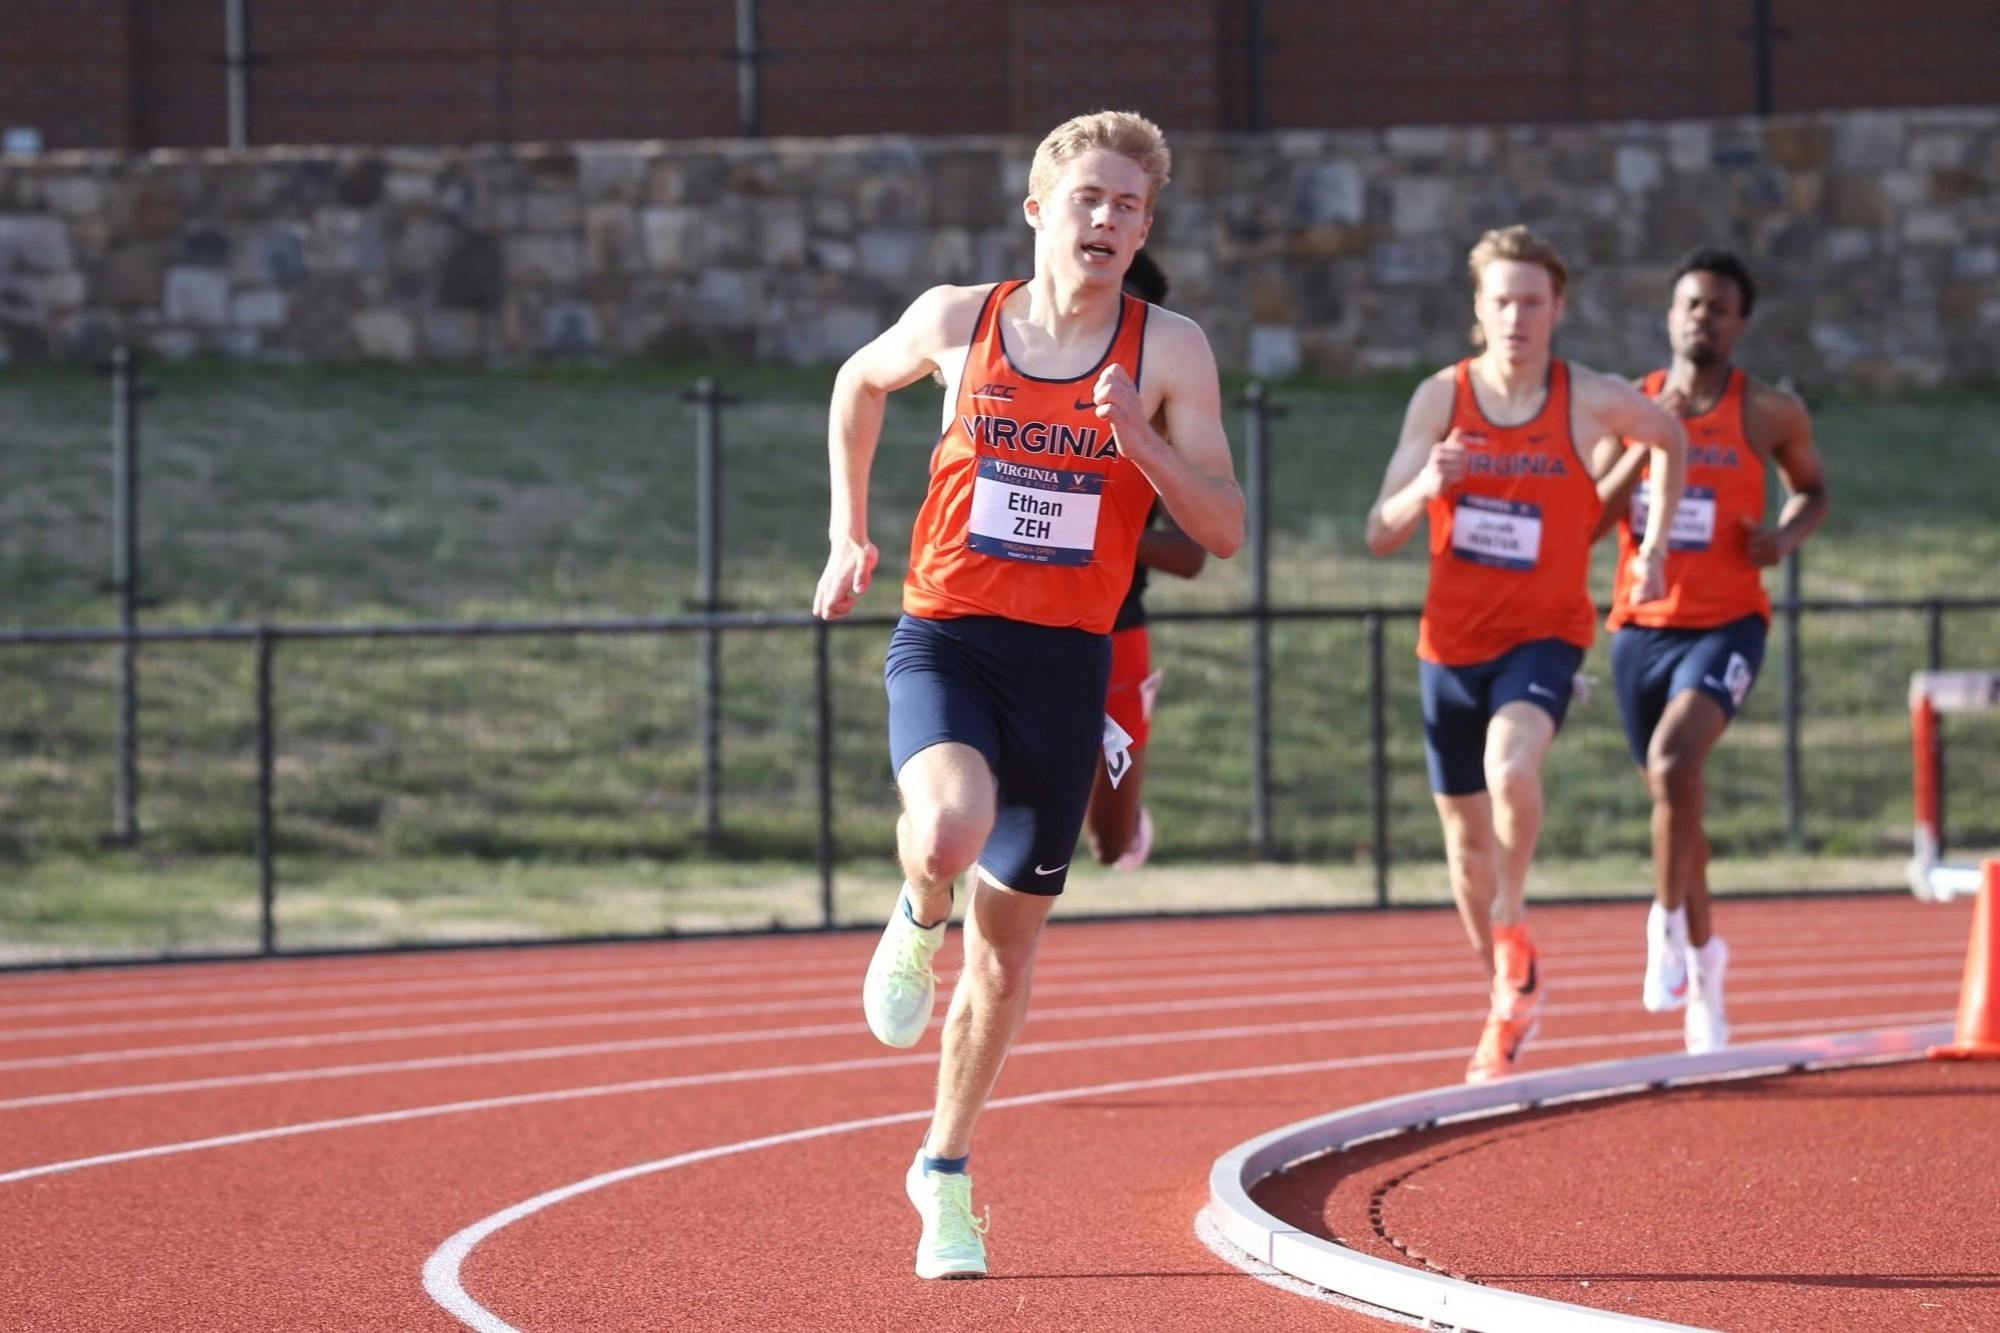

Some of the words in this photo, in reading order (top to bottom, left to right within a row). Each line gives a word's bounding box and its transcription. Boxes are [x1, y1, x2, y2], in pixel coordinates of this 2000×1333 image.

[974, 384, 1018, 398] ACC
[961, 415, 1119, 463] VIRGINIA
[994, 461, 1059, 483] VIRGINIA
[1465, 453, 1567, 477] IRGINIA
[1008, 492, 1062, 517] Ethan
[1013, 517, 1051, 539] ZEH
